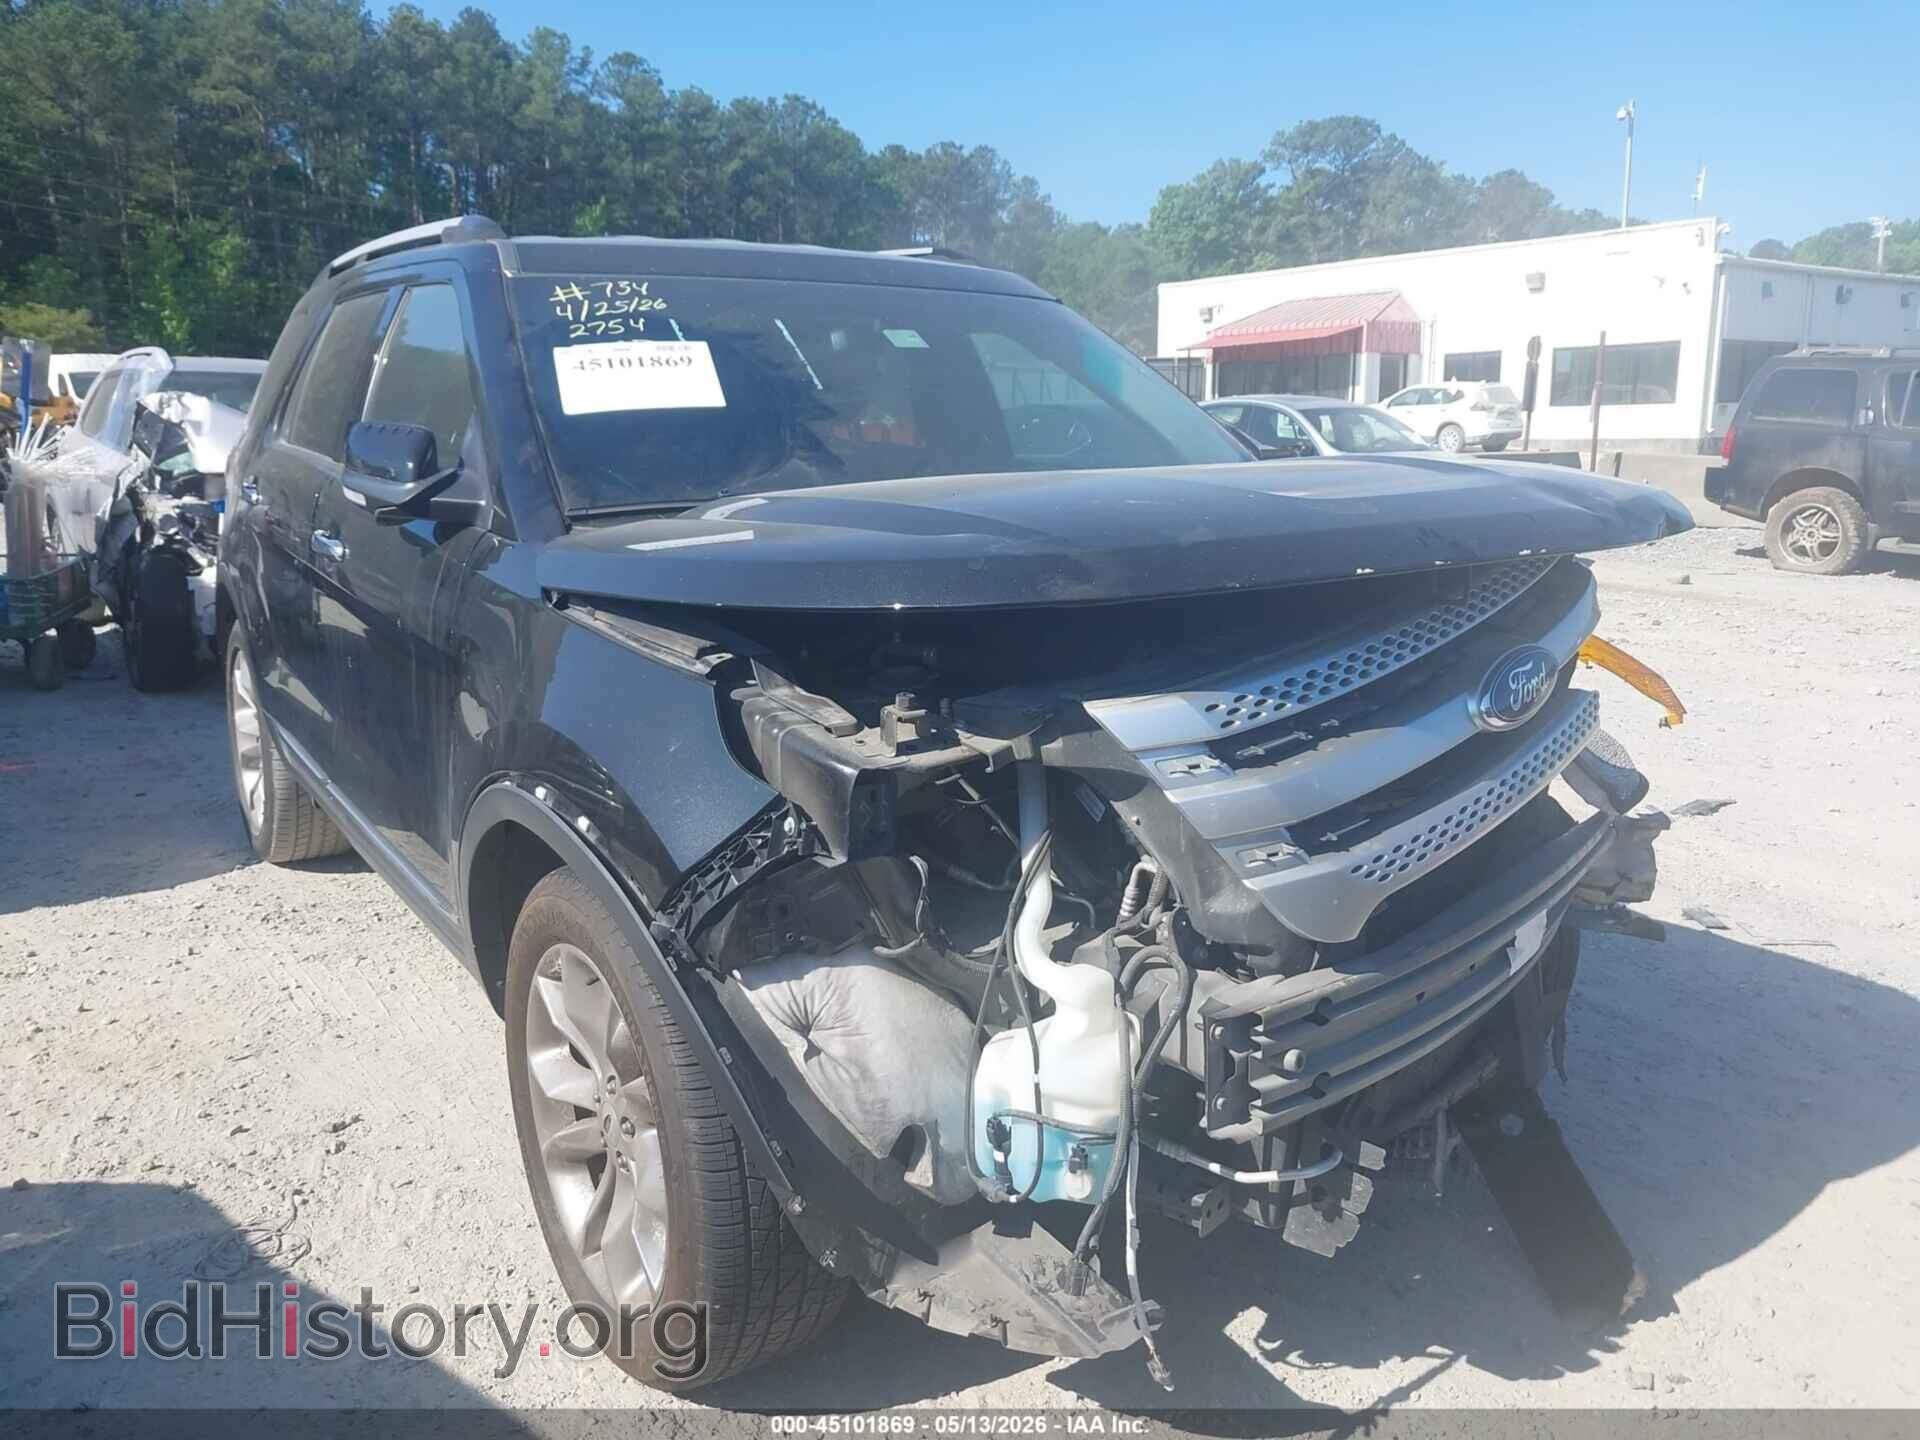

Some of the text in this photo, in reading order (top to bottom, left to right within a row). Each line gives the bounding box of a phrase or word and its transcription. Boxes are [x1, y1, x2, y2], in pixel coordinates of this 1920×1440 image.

[569, 317, 646, 339] 2754
[572, 355, 694, 371] 45101869
[1508, 660, 1546, 712] Ford
